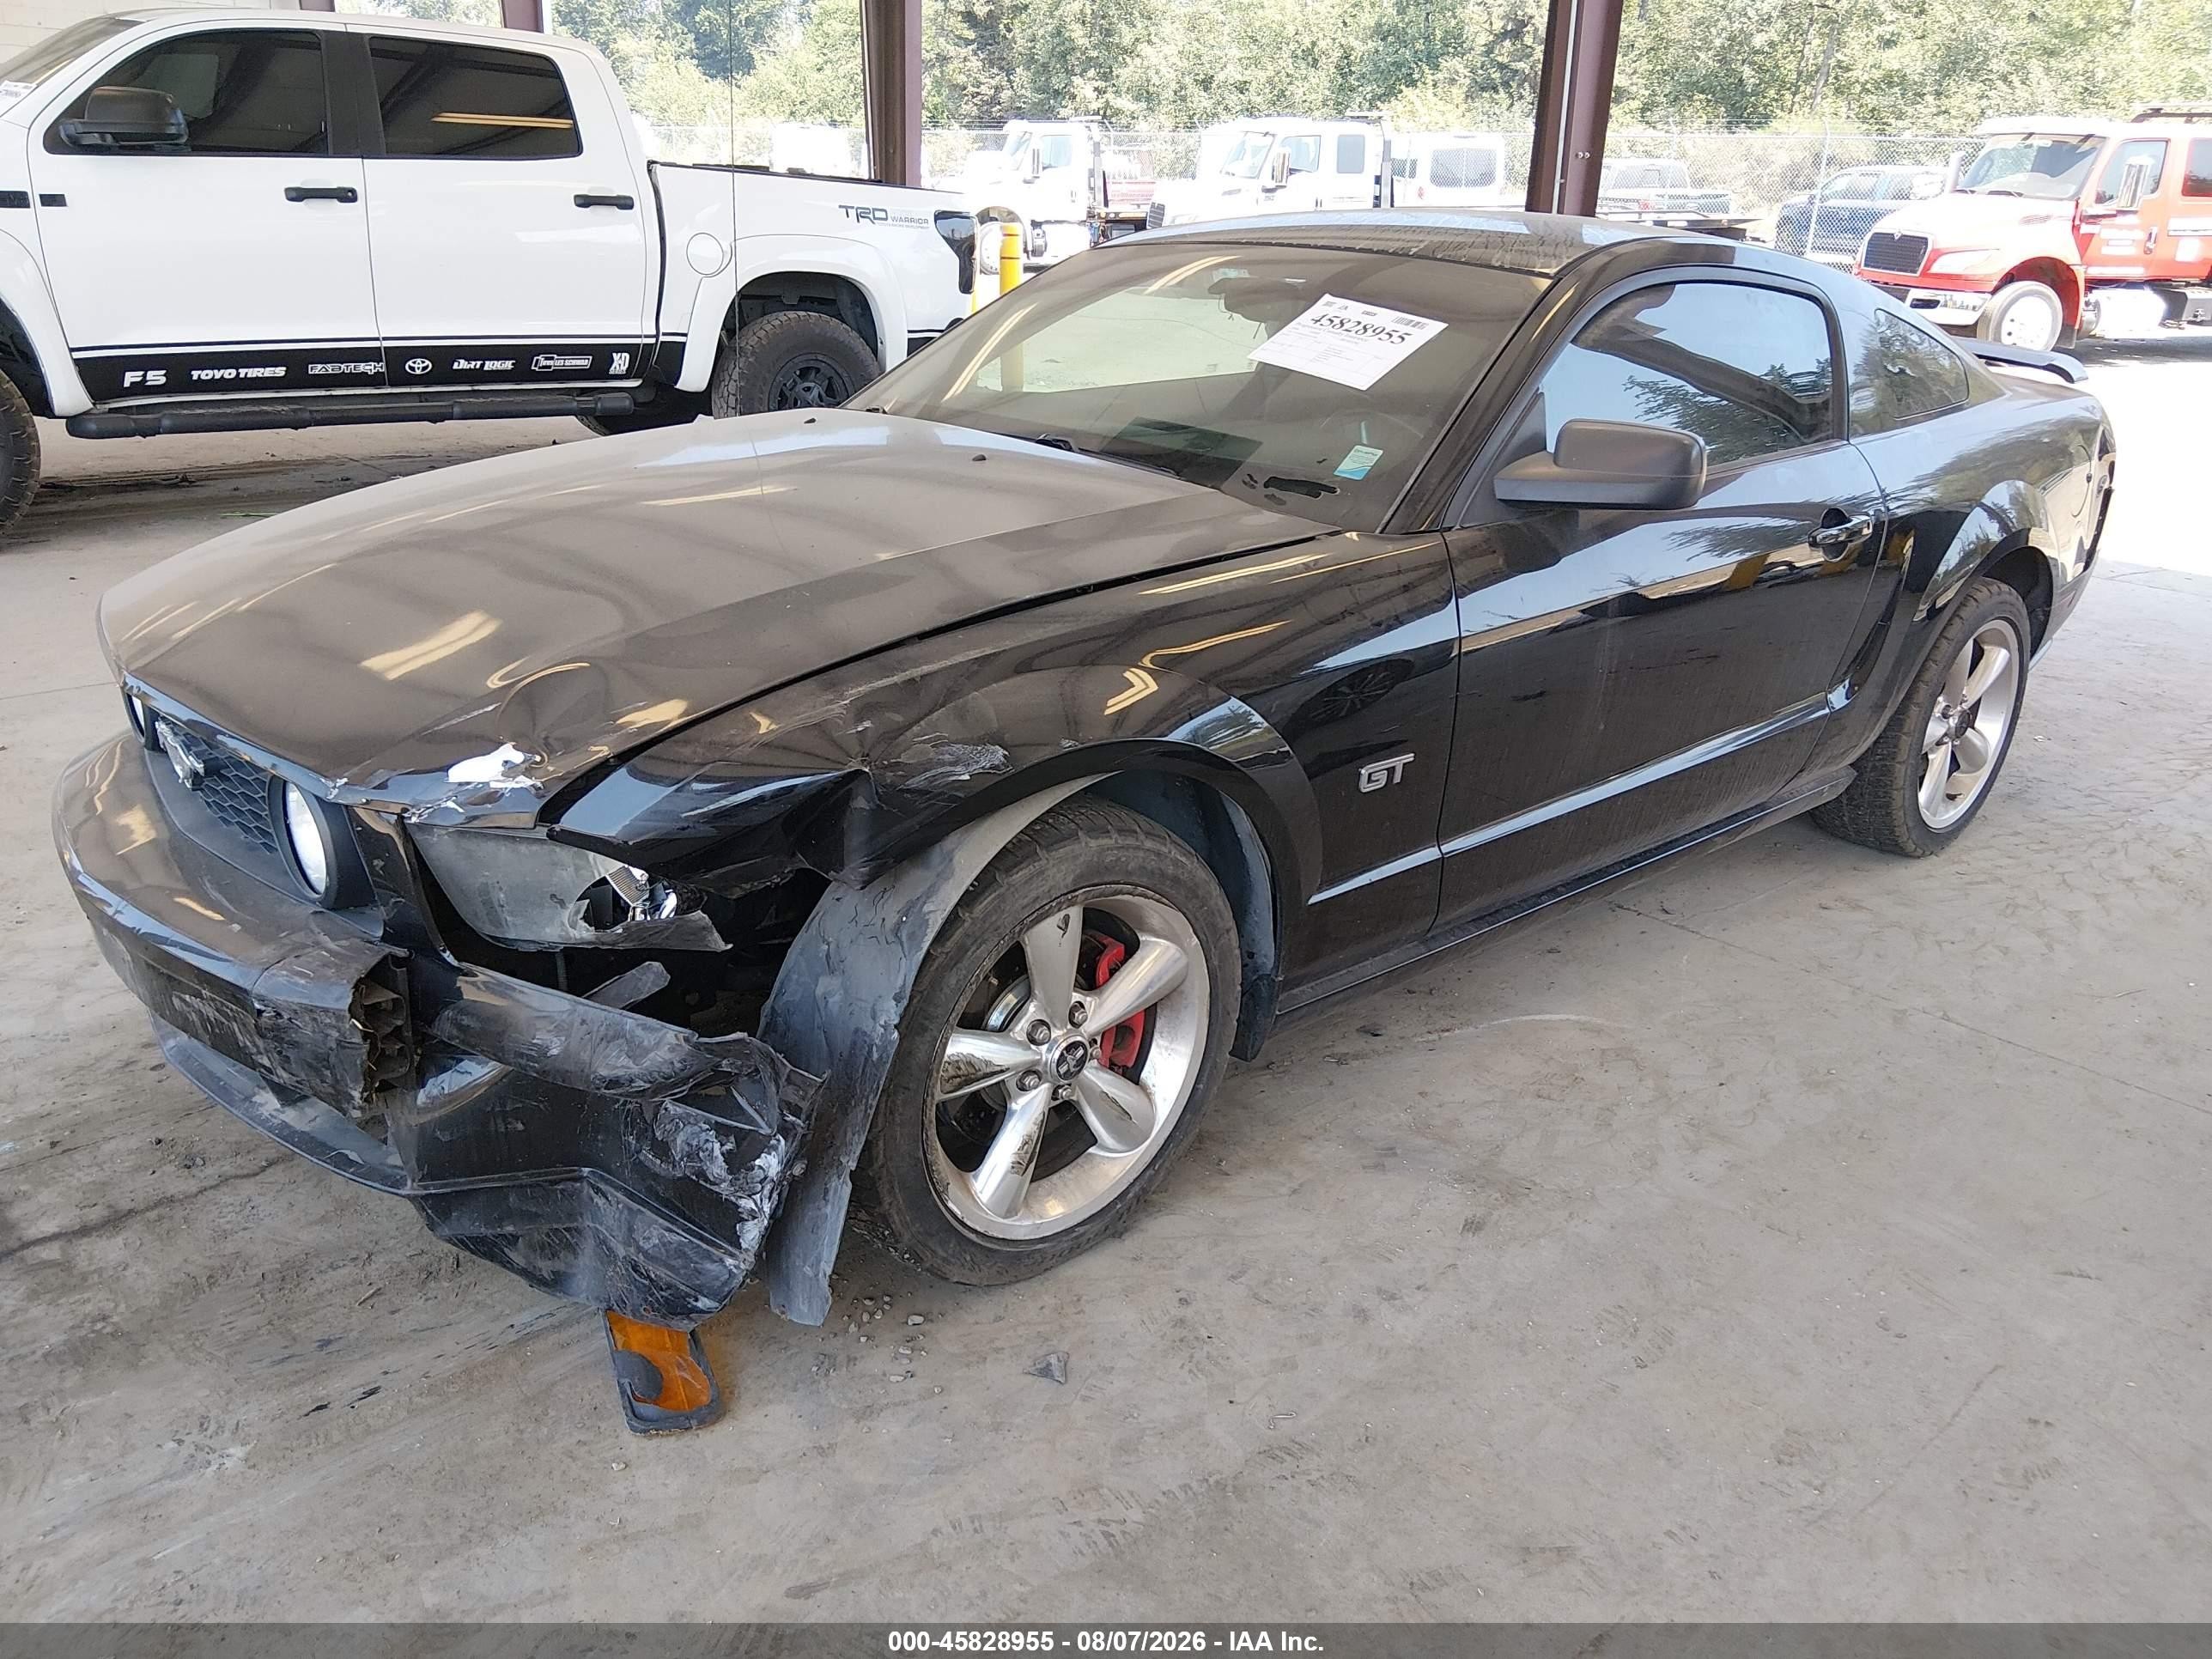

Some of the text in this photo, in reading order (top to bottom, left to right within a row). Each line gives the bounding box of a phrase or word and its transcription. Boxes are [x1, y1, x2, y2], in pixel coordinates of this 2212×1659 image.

[838, 204, 929, 225] TRD WARRIOR
[1310, 313, 1413, 344] 45828955
[123, 369, 167, 388] F5
[191, 366, 287, 380] TOYO TIRES
[308, 362, 385, 375] FABTECH
[1358, 753, 1415, 793] GT
